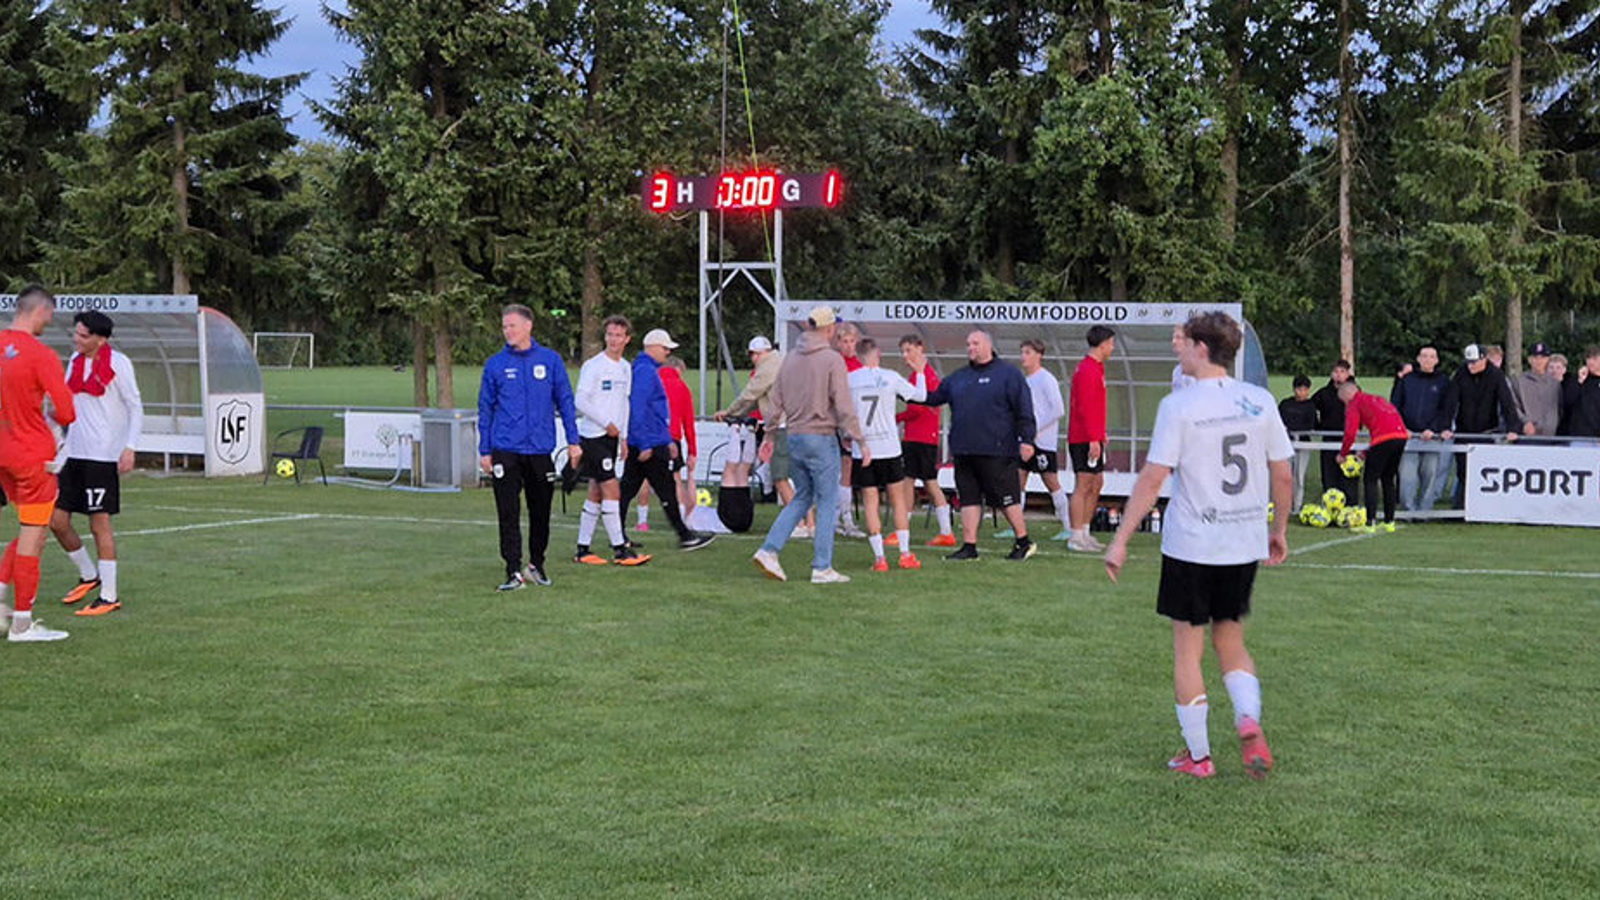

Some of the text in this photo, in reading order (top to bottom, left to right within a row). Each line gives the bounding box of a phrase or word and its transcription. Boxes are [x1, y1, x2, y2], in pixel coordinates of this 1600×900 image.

[652, 178, 668, 208] 3
[677, 182, 694, 203] H
[782, 179, 800, 200] G
[827, 174, 835, 203] 1
[60, 298, 119, 311] FODBOLD
[861, 395, 879, 427] 7
[221, 407, 246, 451] LSF
[1222, 433, 1248, 496] 5
[85, 488, 106, 506] 17
[1480, 467, 1593, 496] SPORT
